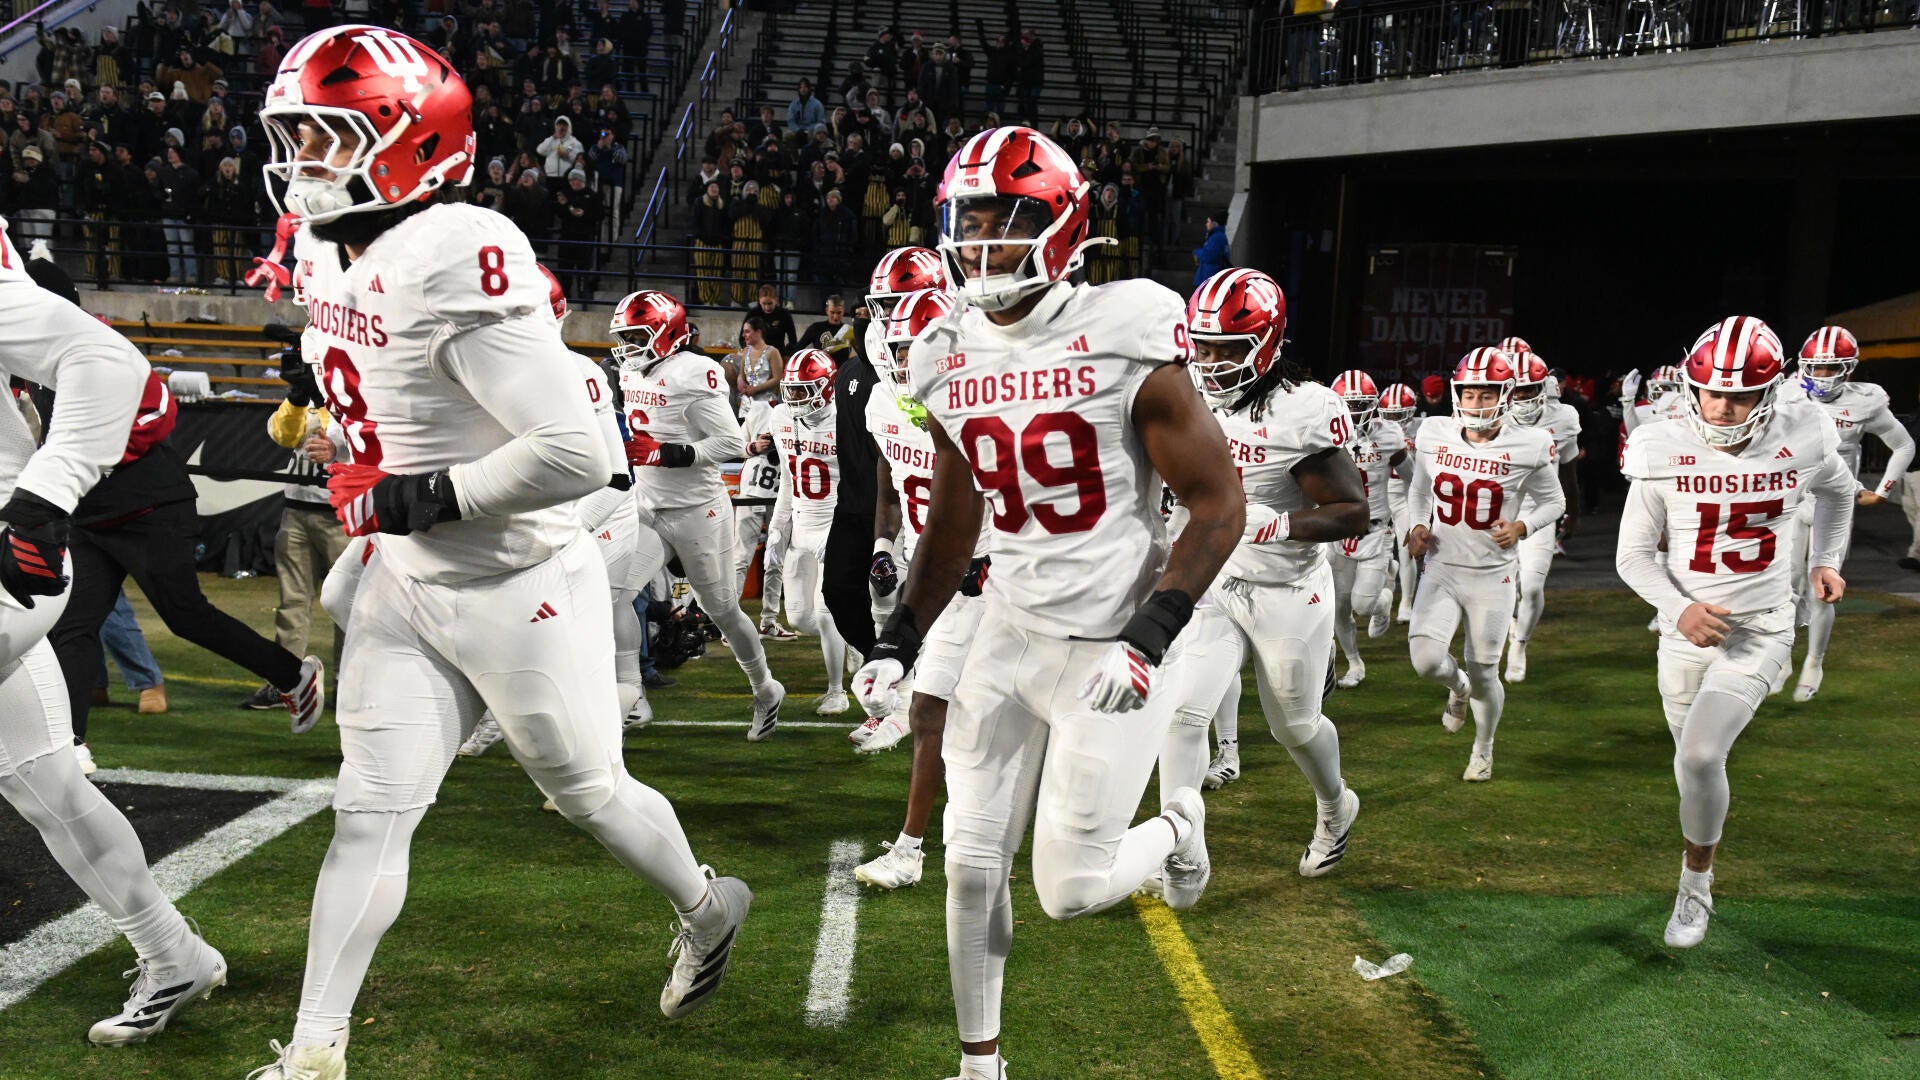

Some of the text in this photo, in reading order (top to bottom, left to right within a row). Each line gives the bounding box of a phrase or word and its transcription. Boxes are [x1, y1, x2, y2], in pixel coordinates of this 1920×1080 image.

[478, 245, 509, 297] 8
[1391, 287, 1488, 314] NEVER
[1370, 316, 1505, 345] DAUNTED
[706, 369, 718, 389] 6
[948, 365, 1096, 410] HOOSIERS
[781, 438, 838, 456] HOSIERS
[1329, 415, 1349, 447] 91
[788, 454, 831, 500] 10
[960, 410, 1107, 535] 99
[1435, 453, 1511, 476] HOOSIERS
[1676, 469, 1798, 494] HOOSIERS
[1433, 471, 1504, 531] 90
[1689, 498, 1784, 574] 15
